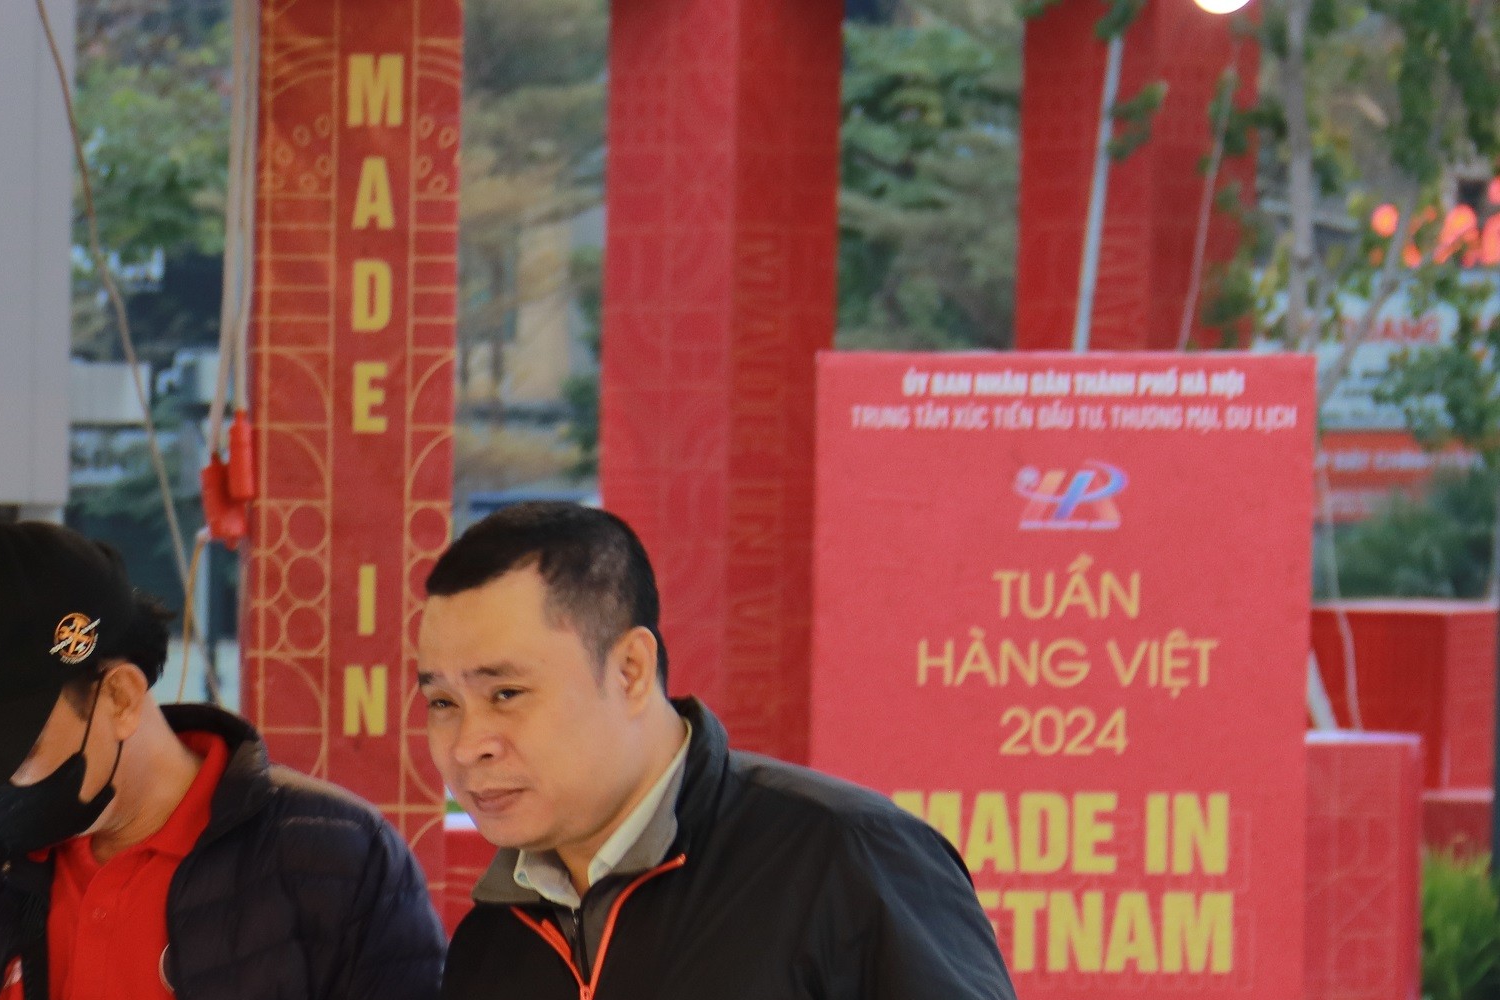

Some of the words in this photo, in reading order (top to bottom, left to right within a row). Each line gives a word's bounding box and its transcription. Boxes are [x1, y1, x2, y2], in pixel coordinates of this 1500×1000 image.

[347, 53, 404, 435] MADE
[993, 554, 1141, 618] TUẦN
[342, 564, 388, 738] IN
[918, 628, 1090, 687] HÀNG
[1108, 630, 1218, 697] VIỆT
[1000, 706, 1128, 757] 2024
[1145, 791, 1230, 876] IN
[976, 891, 1234, 975] TNAM
